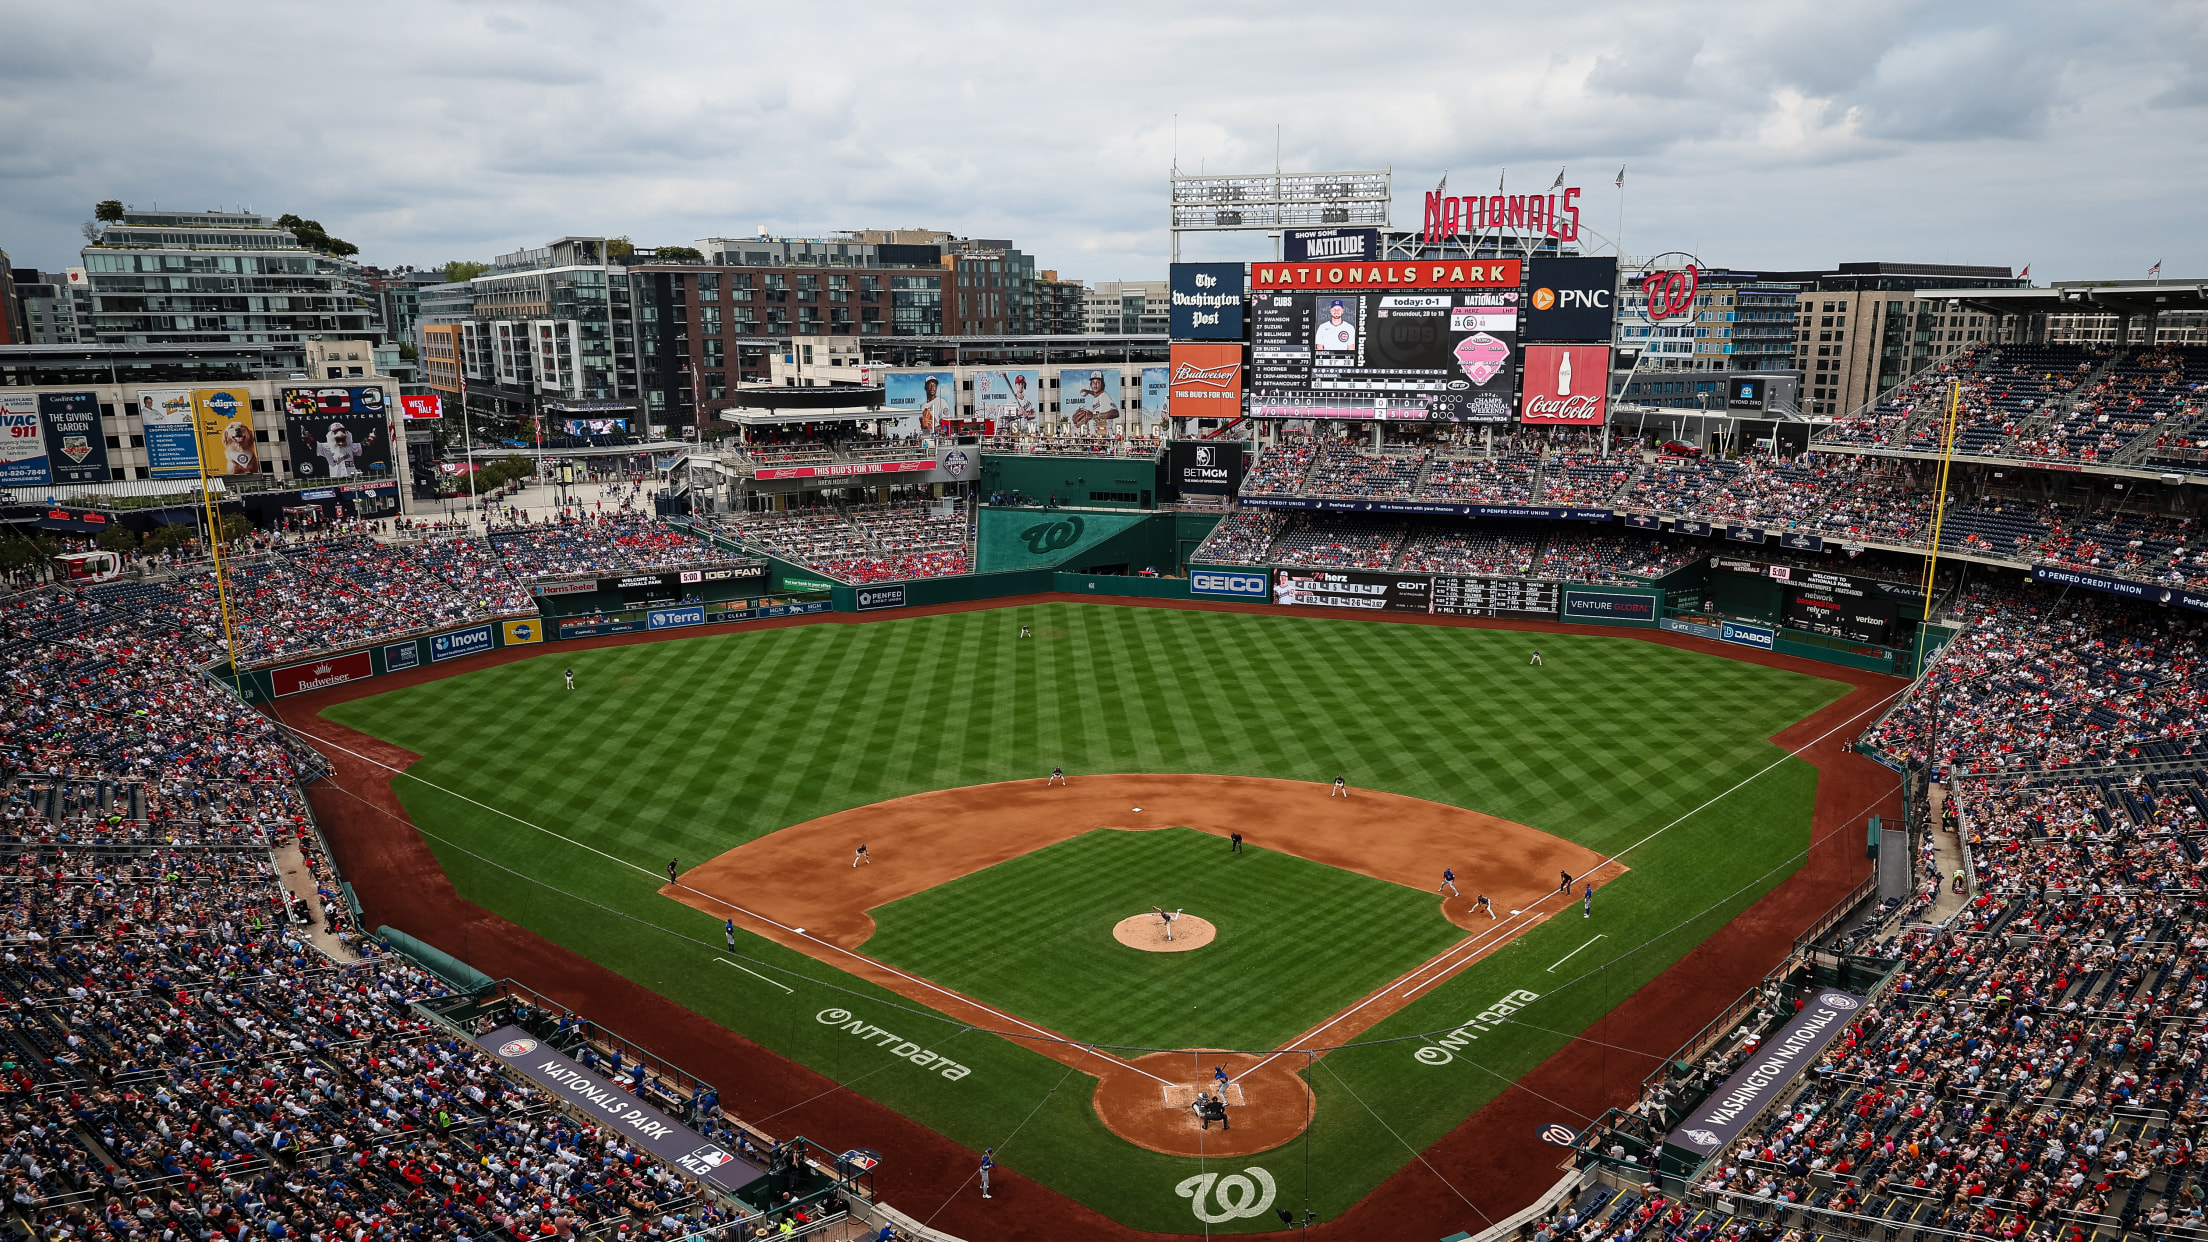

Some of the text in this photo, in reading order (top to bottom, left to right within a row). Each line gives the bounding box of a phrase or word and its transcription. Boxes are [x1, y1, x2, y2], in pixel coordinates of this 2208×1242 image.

[1424, 187, 1580, 244] NATIONALS
[1295, 229, 1338, 239] SHOW SOME
[1306, 235, 1365, 257] NATITUDE
[1195, 273, 1217, 288] The
[1260, 265, 1505, 284] NATIONALS PARK
[1172, 290, 1241, 309] Washington
[1273, 296, 1293, 307] CUBS
[1394, 298, 1439, 307] today: 0-1
[1464, 295, 1505, 307] NATIONALS
[1558, 289, 1610, 308] PNC
[1192, 312, 1219, 328] Post
[1357, 295, 1368, 367] michael busch
[1176, 367, 1233, 380] Budweiser
[1208, 391, 1221, 399] FOR
[1221, 391, 1236, 399] YOU.
[202, 400, 243, 409] Pedigree
[408, 400, 425, 408] WEST
[418, 406, 433, 414] HALF
[1525, 394, 1601, 419] Coca-Cola
[0, 415, 37, 426] VAC
[48, 412, 94, 422] THE GIVING
[11, 426, 37, 438] 911
[57, 422, 89, 432] GARDEN
[813, 464, 884, 476] THIS BUD'S FOR YOU.
[1183, 467, 1228, 478] BETMGM
[1720, 560, 1750, 568] WASHINGTON
[683, 572, 698, 581] 5:00
[734, 567, 761, 577] FAN
[1325, 573, 1348, 582] herz
[1772, 568, 1787, 577] 5:00
[1812, 572, 1839, 581] WELCOME
[1193, 575, 1264, 593] GEICO
[1396, 582, 1428, 590] GDIT
[1807, 577, 1837, 586] NATIONALS
[2048, 571, 2142, 595] PENFED CREDIT UNION
[544, 584, 596, 594] Harris Teeter
[872, 590, 902, 600] PENFED
[1804, 592, 1834, 602] network
[1570, 599, 1650, 612] VENTURE GLOBAL
[1796, 597, 1842, 610] baseball fans
[1806, 605, 1820, 614] rely
[665, 612, 700, 623] Terra
[1855, 614, 1884, 626] verizon
[451, 630, 488, 647] Inova
[1734, 630, 1772, 644] DABOS
[840, 1020, 904, 1046] NTT
[1438, 1019, 1490, 1051] NTT
[1705, 1008, 1838, 1126] WASHINGTON NATIONALS
[537, 1060, 674, 1141] NATIONALS PARK
[675, 1153, 712, 1176] MLB
